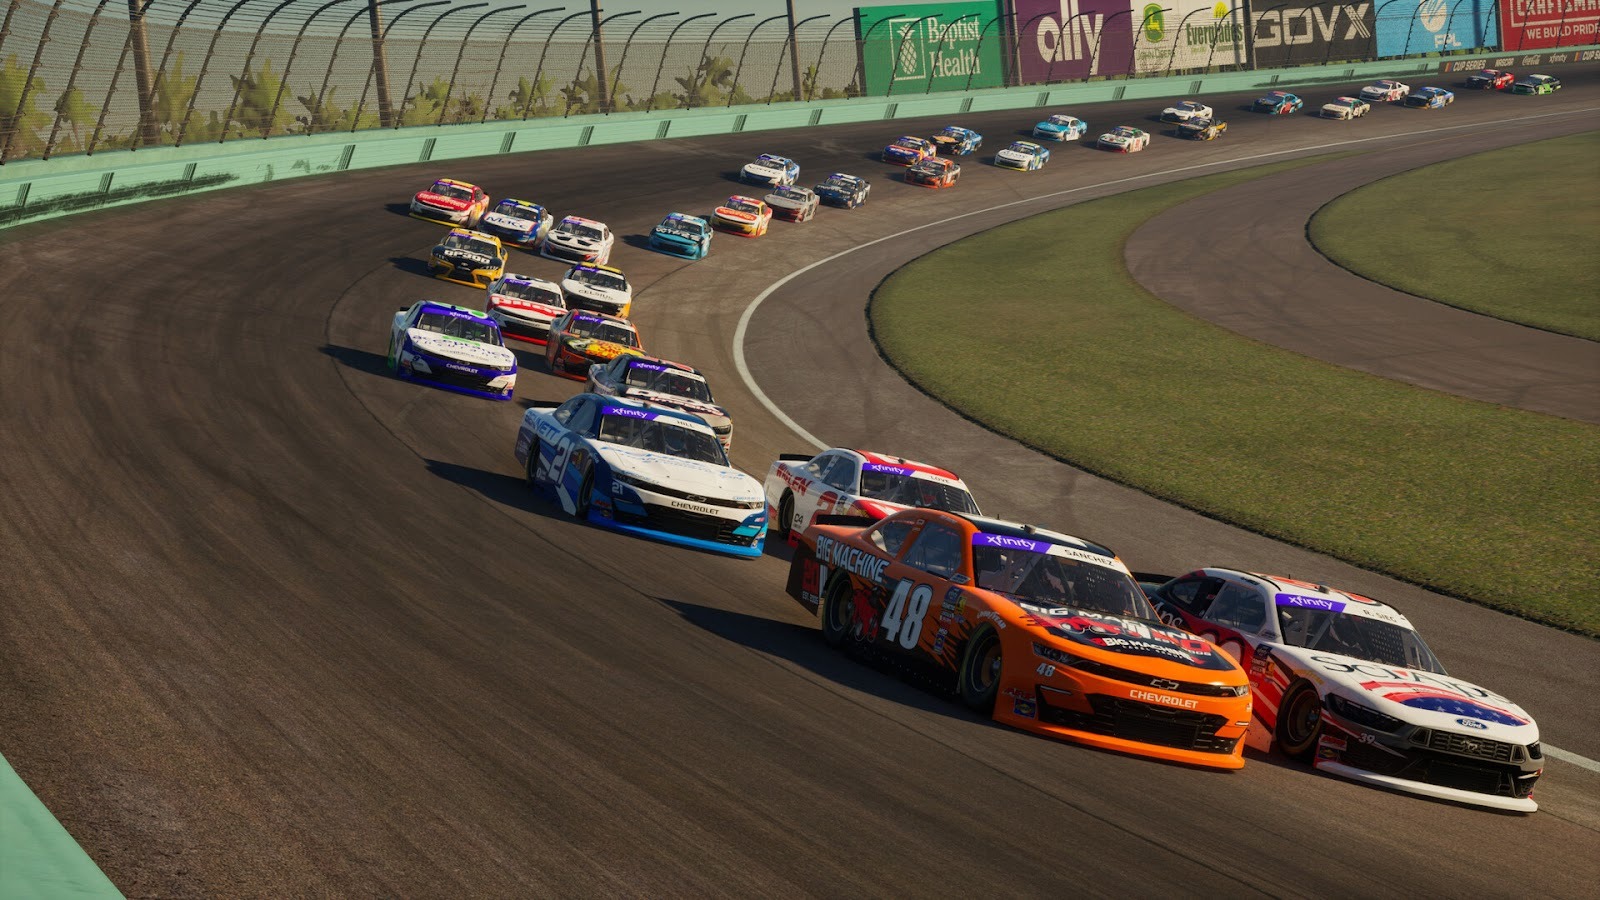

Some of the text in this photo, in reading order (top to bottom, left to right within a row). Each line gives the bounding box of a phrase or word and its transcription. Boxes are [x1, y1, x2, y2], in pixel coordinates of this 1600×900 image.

[927, 16, 980, 49] Baptist
[1253, 4, 1371, 48] GOVX
[1527, 28, 1542, 39] WE
[1543, 26, 1571, 38] BUILD
[1037, 0, 1104, 75] ally
[1186, 21, 1243, 49] Everglades
[1434, 33, 1461, 48] FPL
[929, 51, 982, 78] Health
[1453, 60, 1486, 72] CUP SERIES
[449, 311, 472, 320] xfinity
[446, 363, 479, 374] CHEVROLET
[636, 362, 661, 371] xfinity
[612, 407, 648, 418] xfinity
[676, 420, 695, 428] HILL
[548, 437, 576, 485] 21
[871, 463, 905, 476] xfinity
[611, 481, 624, 495] 21
[671, 500, 720, 515] CHEVROLET
[986, 535, 1036, 551] xfinity
[815, 534, 890, 583] BIG MACHINE
[1064, 549, 1115, 567] SANCHEZ
[1288, 595, 1333, 611] xfinity
[880, 577, 934, 650] 48
[1103, 637, 1130, 647] BIG
[1129, 640, 1195, 663] MACHINE
[1036, 662, 1056, 677] 48
[1129, 689, 1199, 709] CHEVROLET
[1462, 718, 1483, 730] Ford
[1358, 732, 1376, 745] 39
